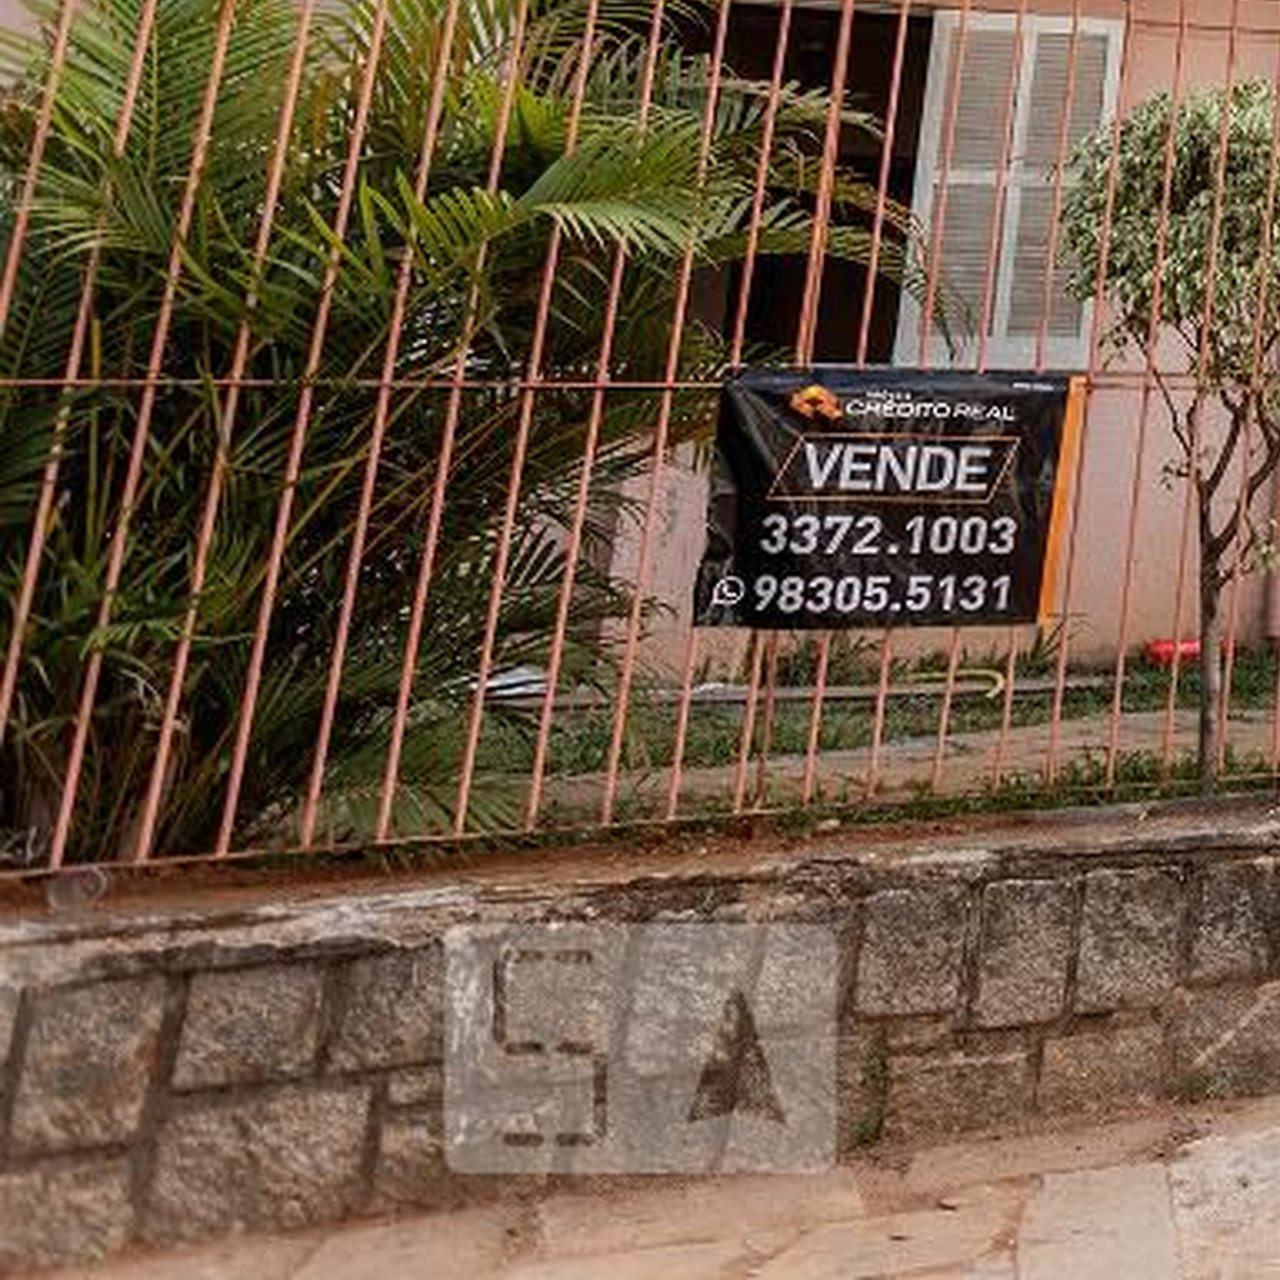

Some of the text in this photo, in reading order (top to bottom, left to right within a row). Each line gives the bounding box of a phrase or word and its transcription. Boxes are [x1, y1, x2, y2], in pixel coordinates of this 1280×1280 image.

[952, 401, 1015, 421] REAL
[804, 443, 992, 493] VENDE
[760, 515, 1018, 555] 3372.1003
[752, 574, 1012, 613] 98305.5131
